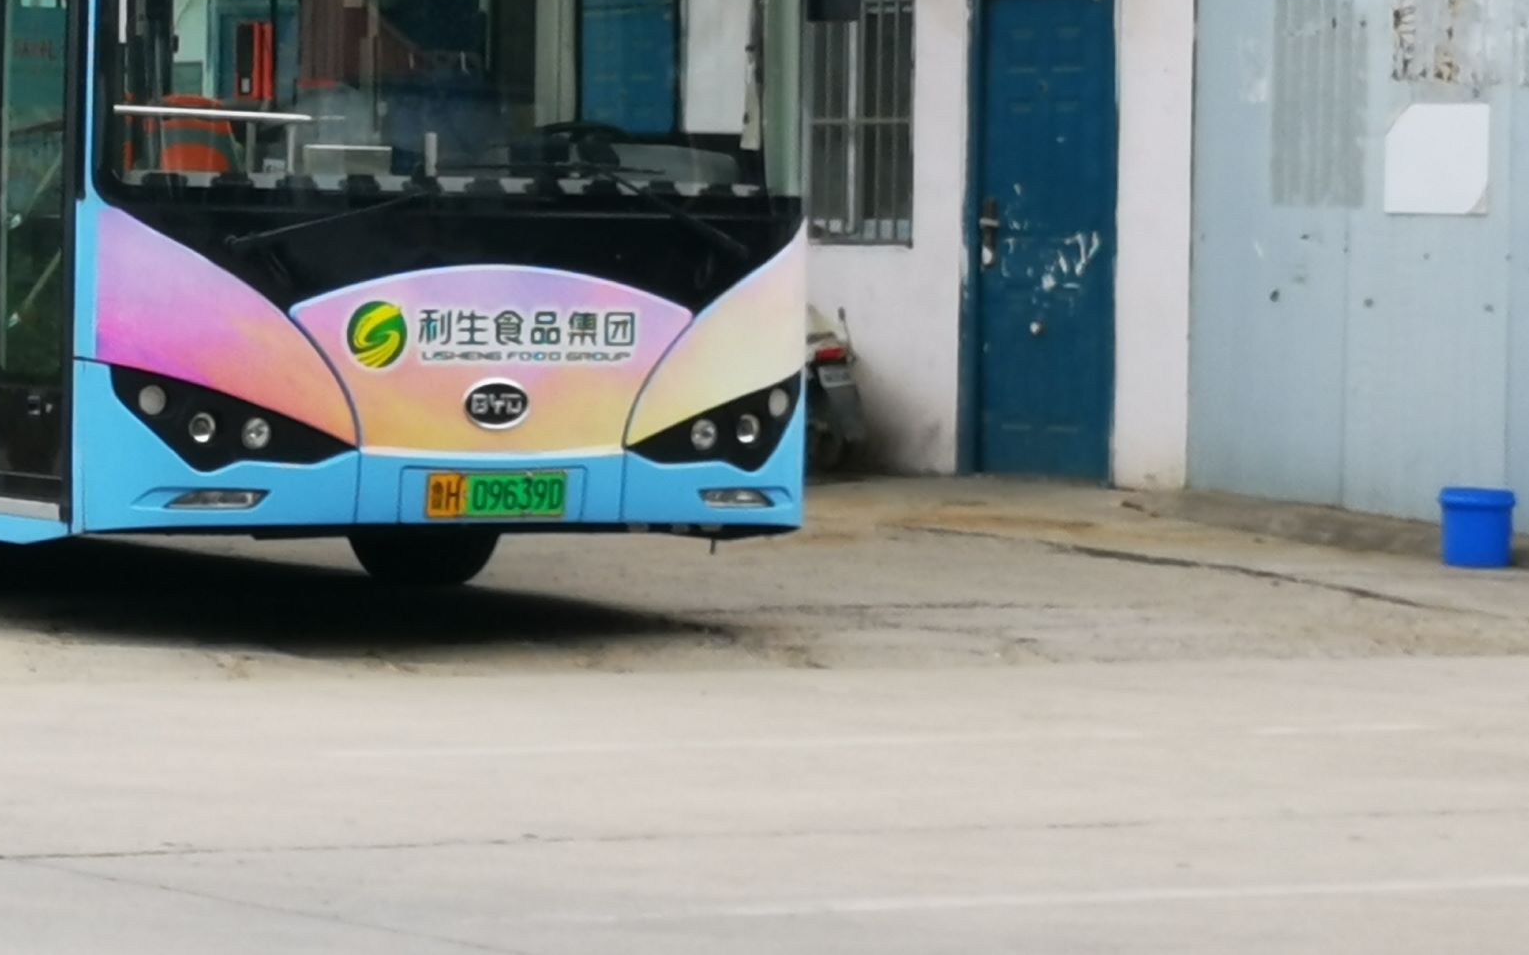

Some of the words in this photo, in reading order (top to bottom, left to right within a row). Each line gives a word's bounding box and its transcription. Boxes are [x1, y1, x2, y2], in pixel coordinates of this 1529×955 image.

[418, 309, 635, 346] 利生食品集团
[422, 350, 502, 362] LISHENG
[507, 350, 561, 362] FOOD
[565, 350, 631, 362] GROUP
[471, 393, 523, 415] BYD
